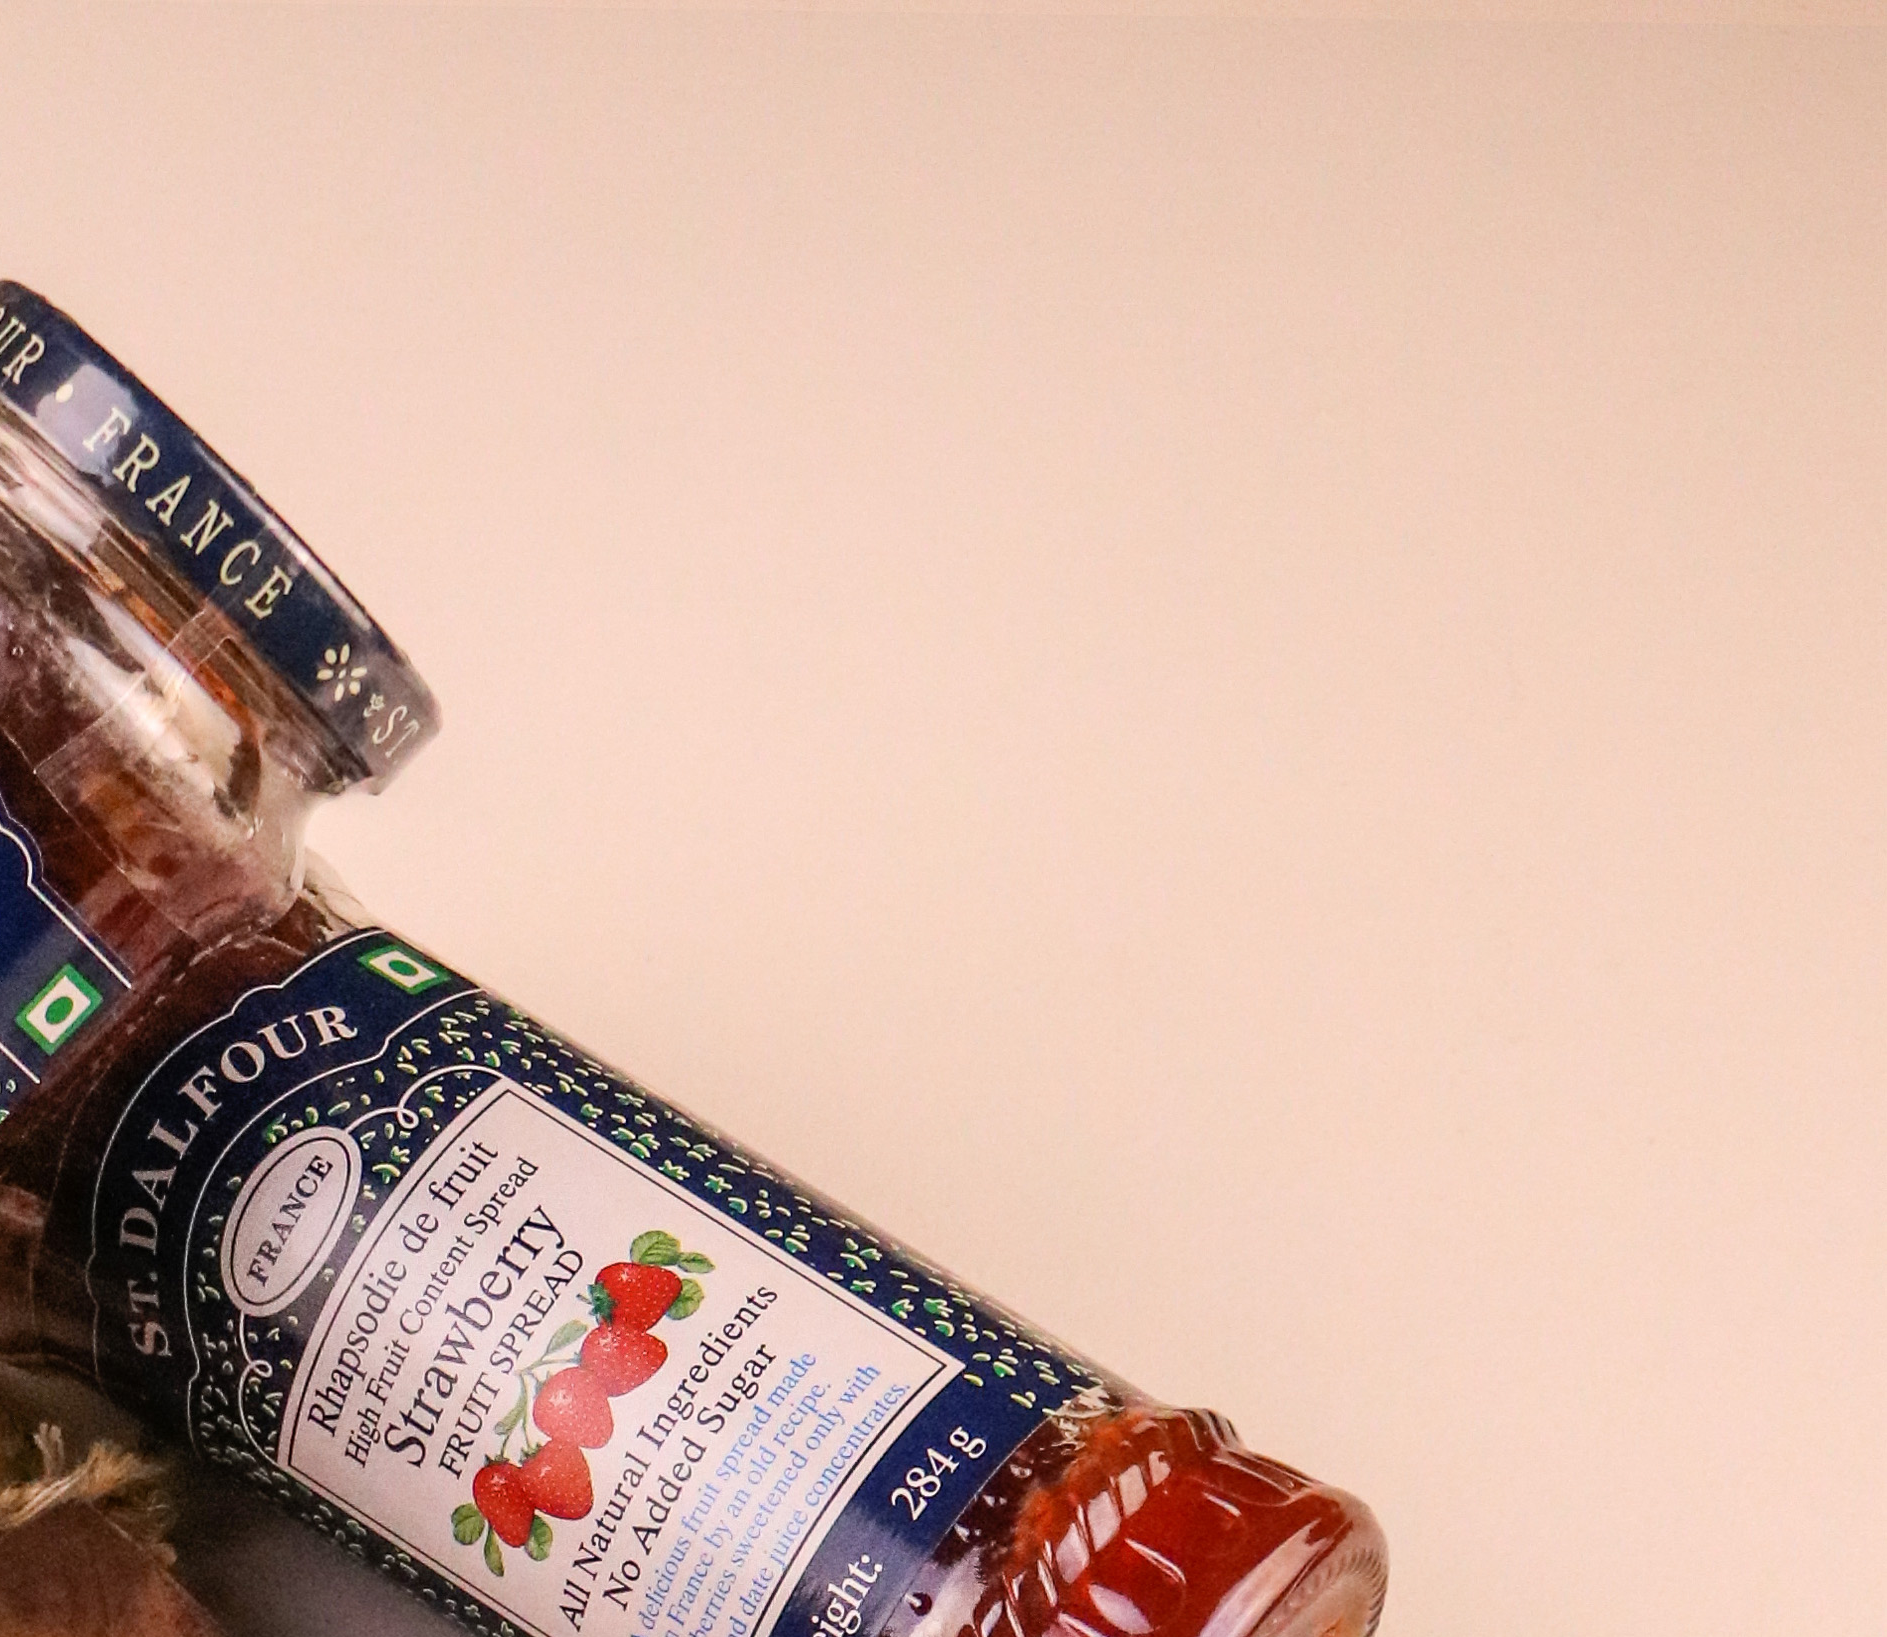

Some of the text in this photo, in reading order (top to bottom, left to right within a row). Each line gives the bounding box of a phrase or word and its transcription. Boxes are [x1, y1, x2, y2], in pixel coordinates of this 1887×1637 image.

[83, 406, 293, 621] FRANCE
[118, 1005, 359, 1358] ST. DALFOUR
[246, 1154, 334, 1287] FRANCE
[306, 1141, 499, 1438] Rhapsodie de fruit
[344, 1155, 540, 1469] High Fruit Content Spread
[383, 1204, 565, 1468] Strawberry
[437, 1248, 584, 1481] FRUIT SPREAD
[558, 1286, 778, 1633] All Natural Ingredients
[601, 1343, 777, 1612] No Added Sugar
[637, 1536, 692, 1632] delicious
[680, 1482, 722, 1535] fruit
[715, 1403, 773, 1481] spread
[767, 1352, 817, 1408] made
[666, 1552, 714, 1627] France
[703, 1519, 733, 1550] by
[726, 1489, 751, 1518] an
[747, 1445, 777, 1485] old
[772, 1384, 832, 1448] recipe.
[731, 1449, 809, 1568] sweetened
[805, 1405, 846, 1451] only
[838, 1365, 881, 1405] with
[738, 1567, 776, 1618] date
[764, 1509, 809, 1573] juice
[804, 1383, 911, 1507] concentrates.
[887, 1445, 961, 1522] 284
[946, 1424, 989, 1462] g
